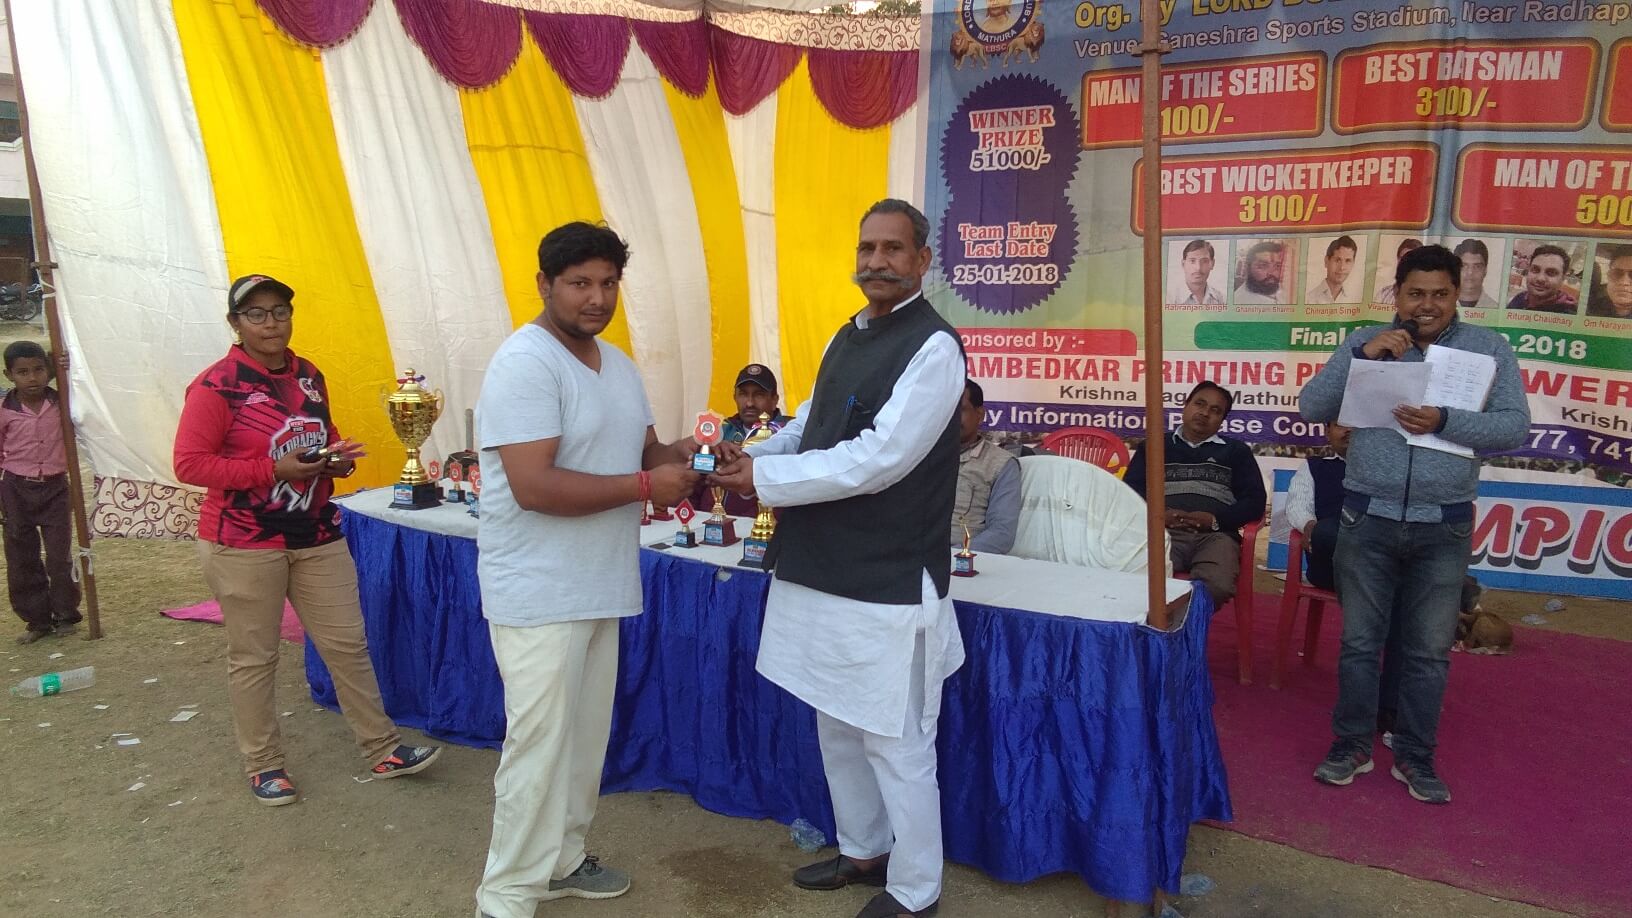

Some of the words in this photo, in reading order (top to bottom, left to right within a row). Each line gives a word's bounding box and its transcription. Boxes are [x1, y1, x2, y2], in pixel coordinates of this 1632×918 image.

[1075, 2, 1131, 31] Org.
[1265, 15, 1344, 43] Sports
[1352, 6, 1456, 32] Stadium,
[1523, 0, 1632, 26] Radhap
[977, 29, 1017, 43] MATHURA
[1364, 52, 1434, 85] BEST
[1436, 50, 1564, 82] BATSMAN
[1090, 77, 1141, 107] MAN
[1179, 70, 1223, 99] THE
[1228, 62, 1317, 97] SERIES
[1415, 86, 1497, 118] 3100/-
[971, 107, 1055, 130] WINNER
[980, 129, 1042, 150] PRIZE
[971, 149, 1051, 170] 51000/-
[1160, 167, 1217, 196] BEST
[1221, 156, 1414, 193] WICKETKEEPER
[1493, 158, 1560, 188] MAN
[1564, 159, 1605, 190] OF
[1239, 194, 1327, 224] 3100/-
[959, 223, 1004, 241] Team
[1007, 222, 1057, 243] Entry
[965, 241, 1002, 258] Last
[1006, 240, 1049, 257] Date
[953, 264, 1058, 285] 25-01-2018
[1339, 306, 1361, 316] Singh
[1043, 332, 1065, 351] by
[1290, 327, 1346, 345] Final
[967, 356, 1120, 382] AMBEDKAR
[1060, 385, 1137, 401] Krishna
[1231, 390, 1300, 407] Mathur
[1561, 406, 1632, 432] Krish
